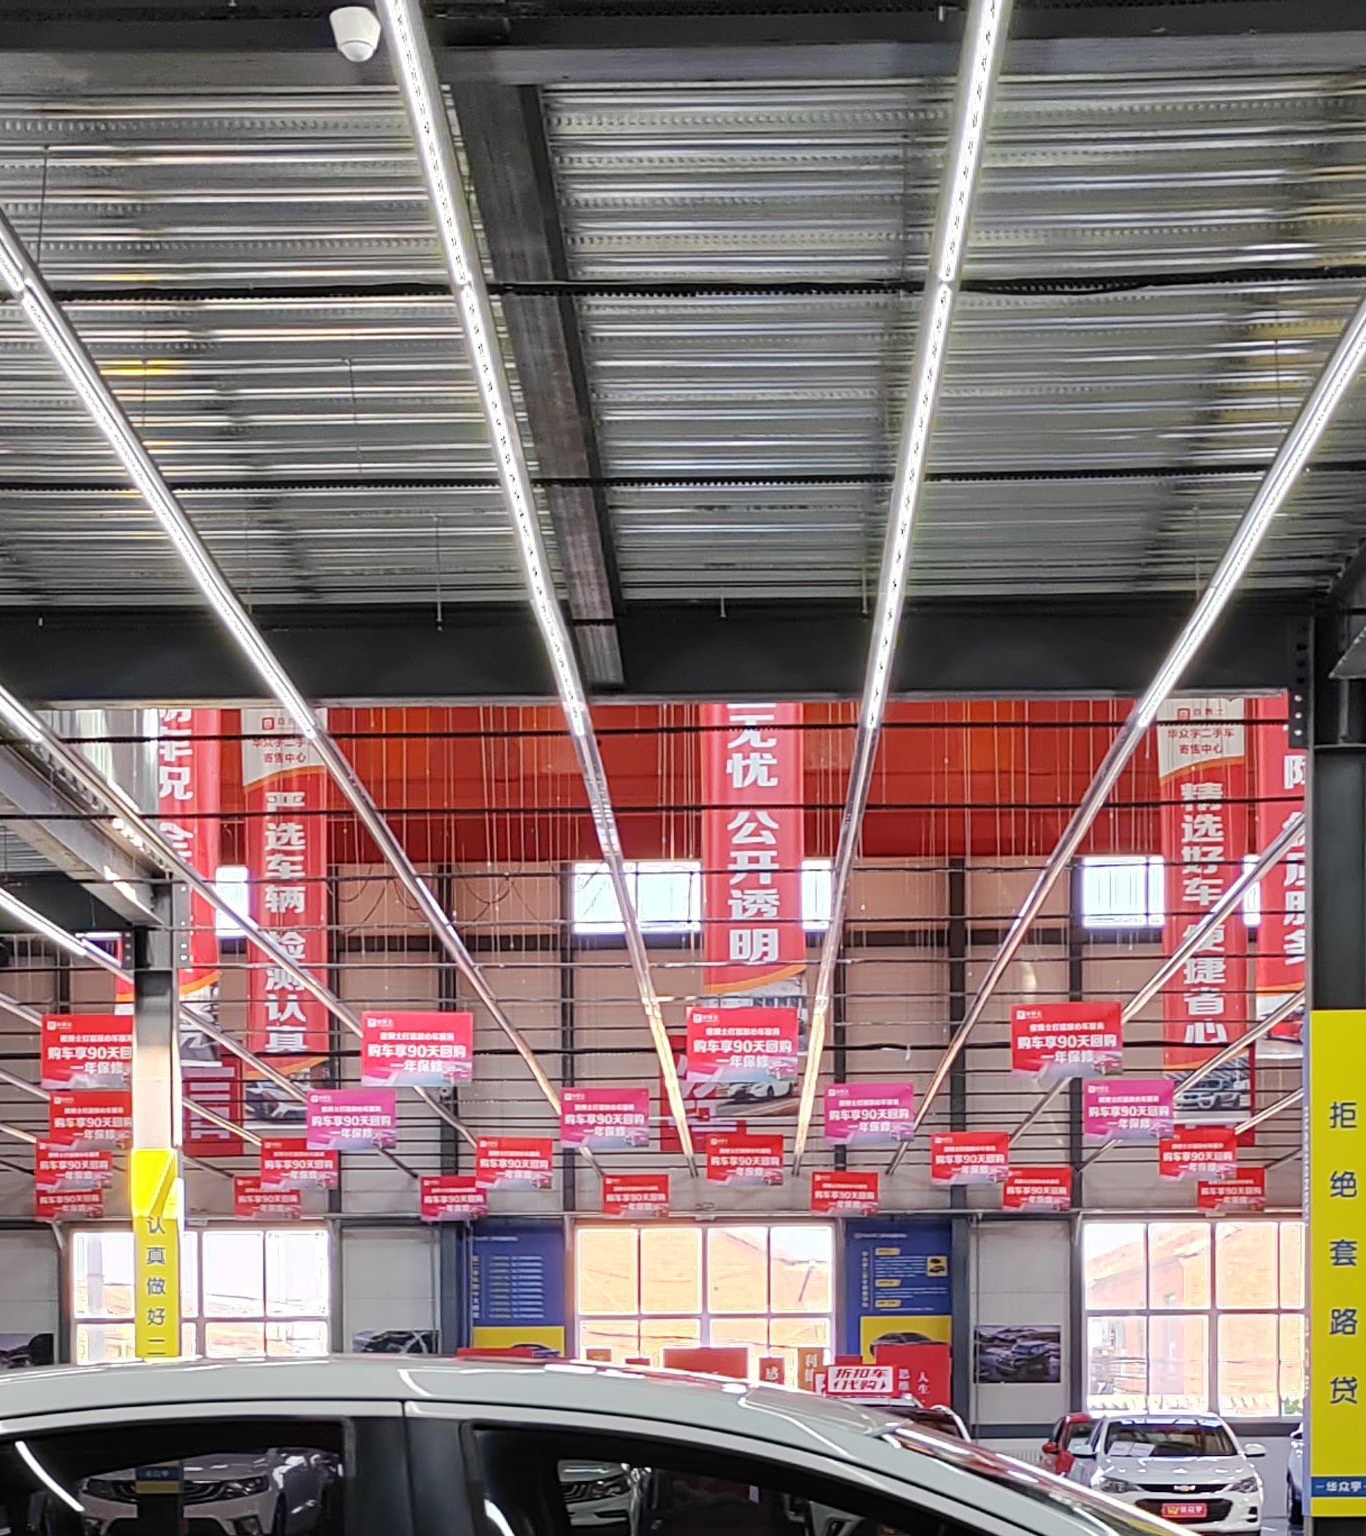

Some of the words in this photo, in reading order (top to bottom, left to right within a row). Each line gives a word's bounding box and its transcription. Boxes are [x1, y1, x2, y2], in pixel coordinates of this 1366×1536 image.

[726, 703, 778, 788] 无忧
[1181, 783, 1225, 906] 精选好车
[265, 791, 306, 914] 严选车辆
[265, 932, 308, 1054] 检测认真
[693, 1040, 792, 1053] 购车享90天回购
[1017, 1034, 1117, 1049] 购车享90天回购
[367, 1044, 467, 1058] 购车享90天回购
[1041, 1051, 1094, 1064] 一年保修
[390, 1060, 444, 1073] 一年保修
[716, 1055, 769, 1068] 一年保修
[829, 1109, 909, 1121] 购车享90天回购
[1089, 1106, 1169, 1118] 购车享90天回购
[311, 1115, 392, 1126] 购车享90天回购
[564, 1114, 645, 1125] 购车享90天回购
[1329, 1101, 1358, 1404] 拒绝套路贷
[1326, 1481, 1361, 1492] 华众宇
